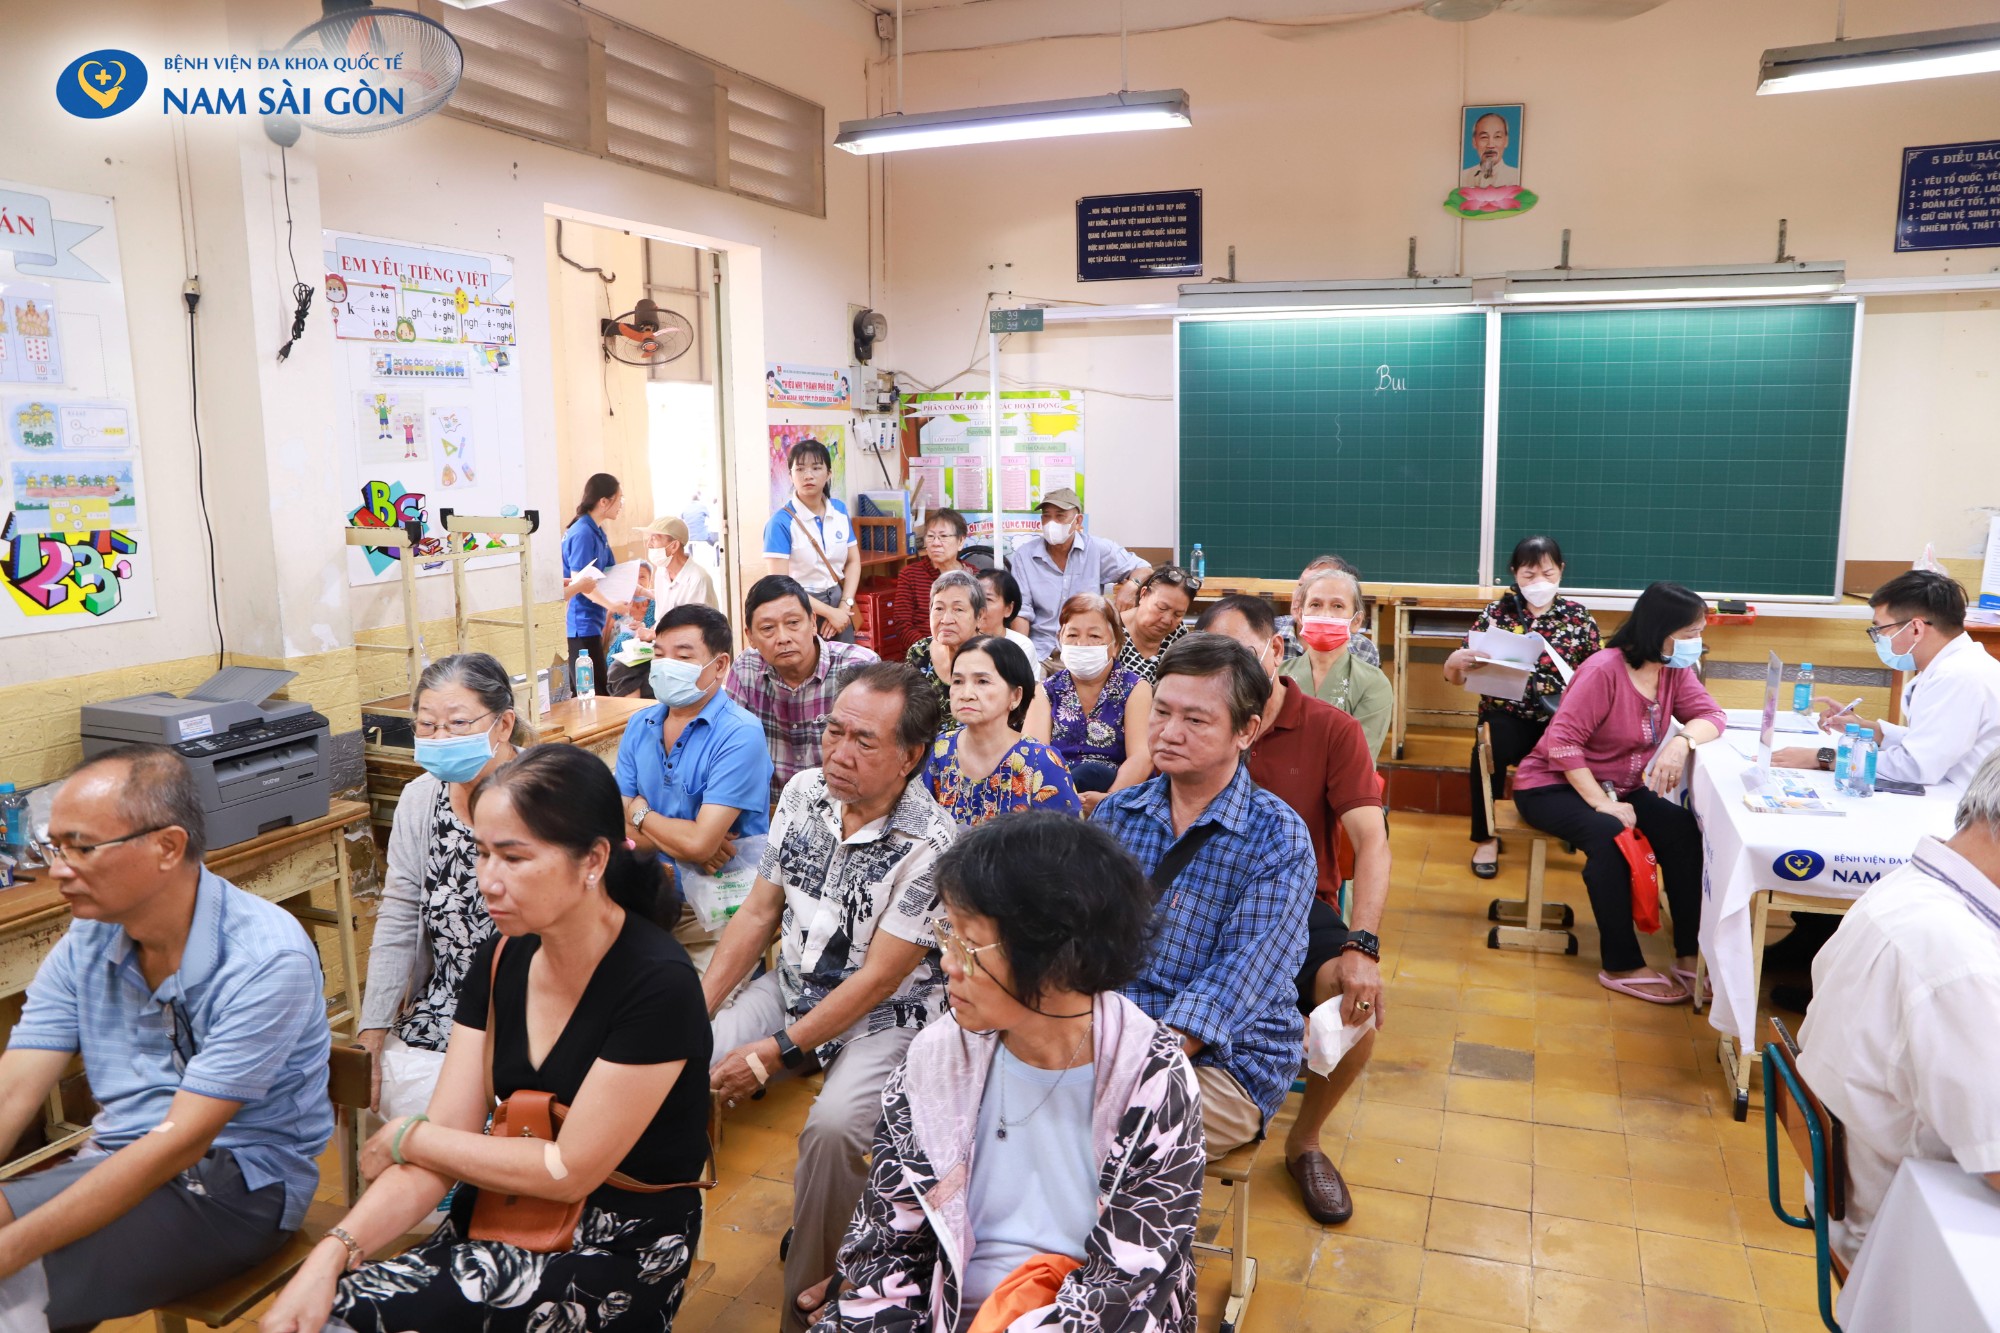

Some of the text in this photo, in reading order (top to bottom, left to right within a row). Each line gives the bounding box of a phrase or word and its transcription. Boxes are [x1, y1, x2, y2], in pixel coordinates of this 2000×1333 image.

[1932, 156, 1940, 164] 5
[1943, 149, 1973, 164] ĐIỀU
[1924, 176, 1942, 185] YÊU
[1924, 189, 1942, 198] HỌC
[1943, 186, 1960, 197] TẬP
[1922, 200, 1946, 209] ĐOÀN
[1968, 210, 1988, 218] SINH
[1920, 223, 1948, 232] KHIÊM
[341, 256, 489, 289] EM YÊU TIẾNG VIỆT
[944, 403, 966, 411] CÔNG
[1037, 402, 1060, 410] ĐỘNG
[1834, 853, 1860, 864] BỆNH
[1863, 855, 1885, 865] VIỆN
[1833, 869, 1880, 883] NAM
